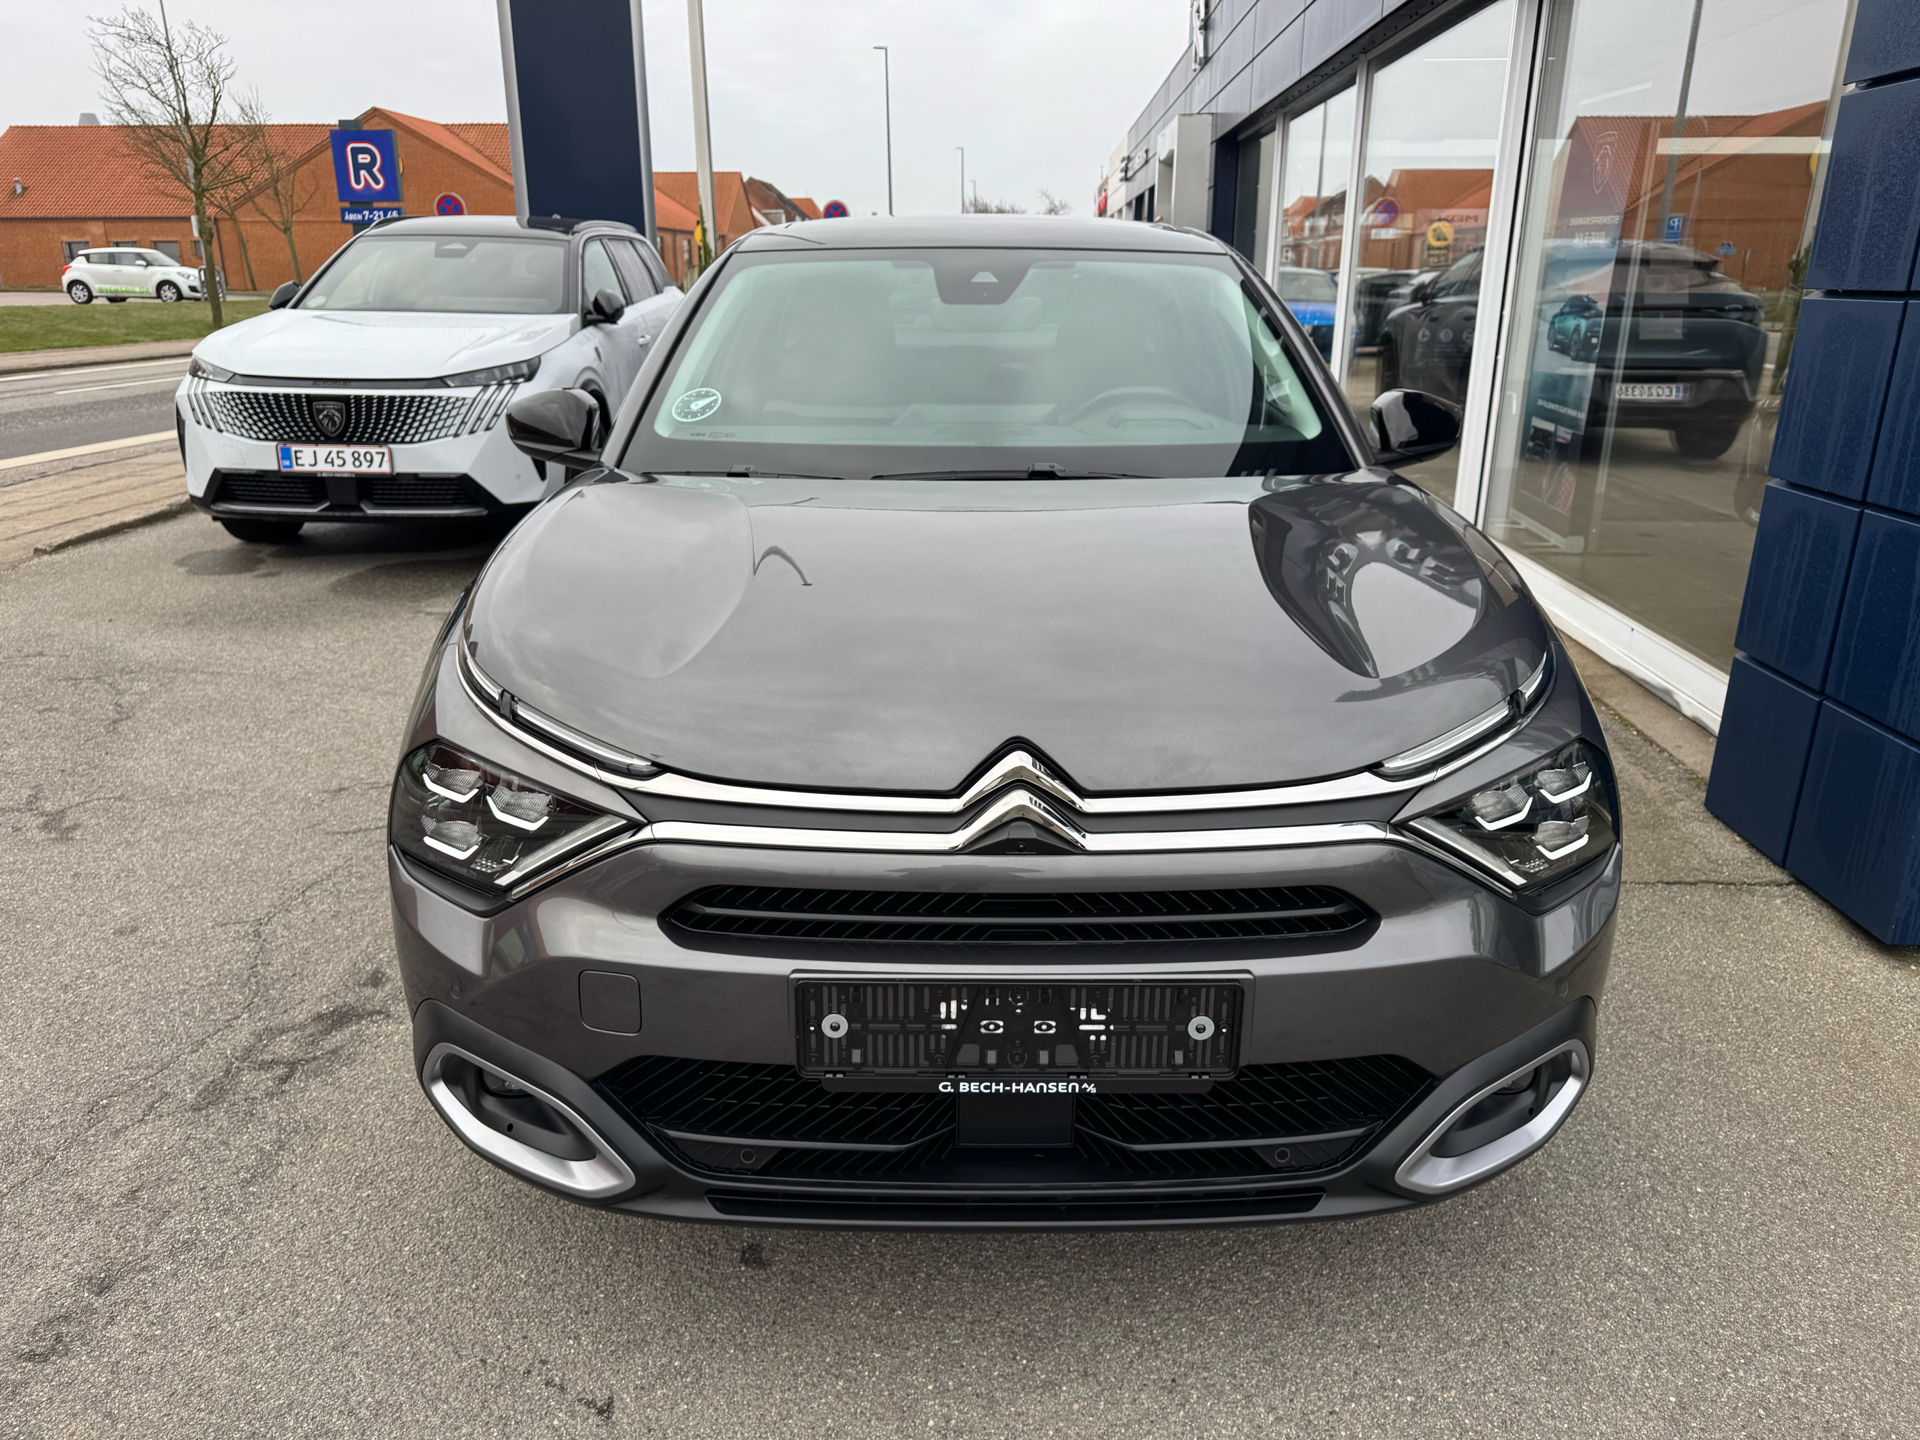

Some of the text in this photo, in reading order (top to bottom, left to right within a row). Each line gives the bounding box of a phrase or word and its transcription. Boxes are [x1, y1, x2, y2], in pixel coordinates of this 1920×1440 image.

[345, 141, 386, 191] R
[293, 449, 386, 468] EJ 45 897
[938, 1081, 955, 1093] G.
[959, 1082, 1079, 1093] BECH-HANSEN
